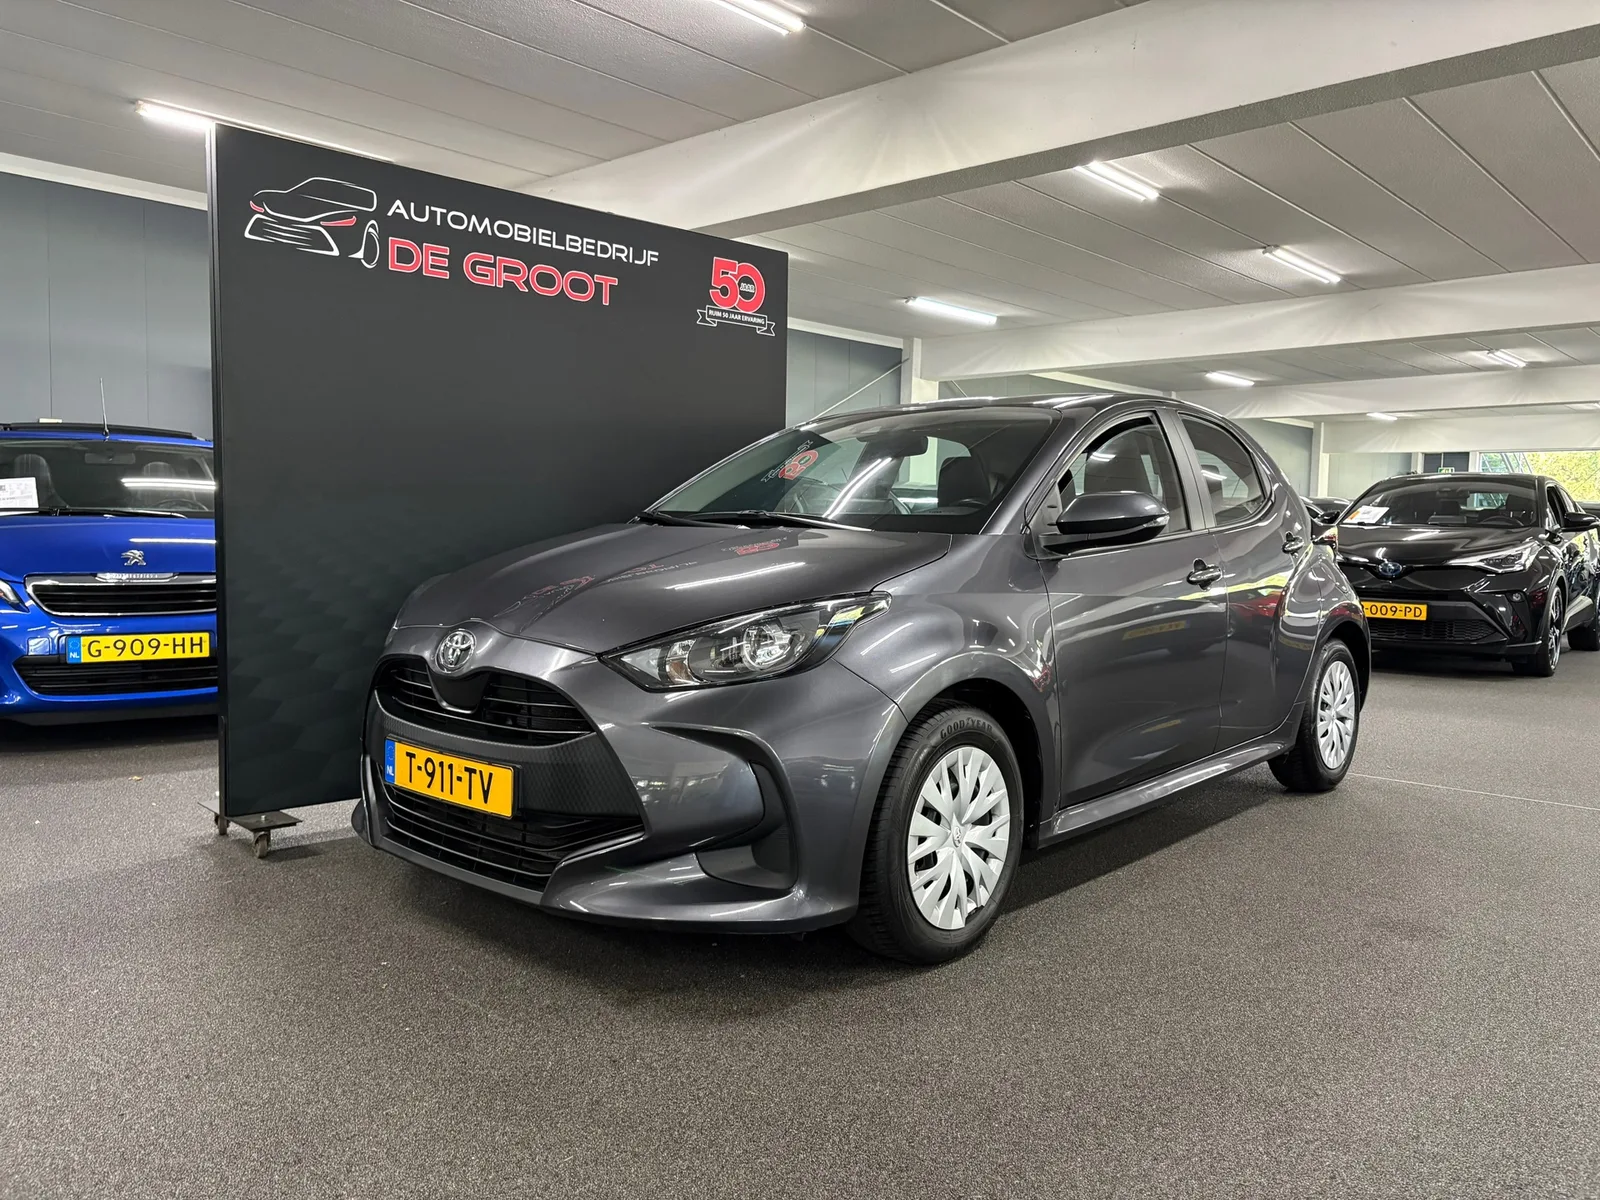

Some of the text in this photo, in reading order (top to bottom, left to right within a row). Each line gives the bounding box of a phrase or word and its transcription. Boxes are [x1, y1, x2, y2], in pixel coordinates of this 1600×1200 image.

[387, 199, 659, 267] AUTOMOBIELBEDRIJF
[388, 236, 618, 306] DE GROOT
[709, 256, 766, 313] 50
[708, 310, 722, 318] RUIM
[729, 312, 741, 320] JAAR
[742, 315, 765, 324] ERVARING
[69, 636, 203, 659] NL G-909-HH
[940, 717, 993, 740] GOODYEAR
[386, 751, 494, 805] NL T-911-TV
